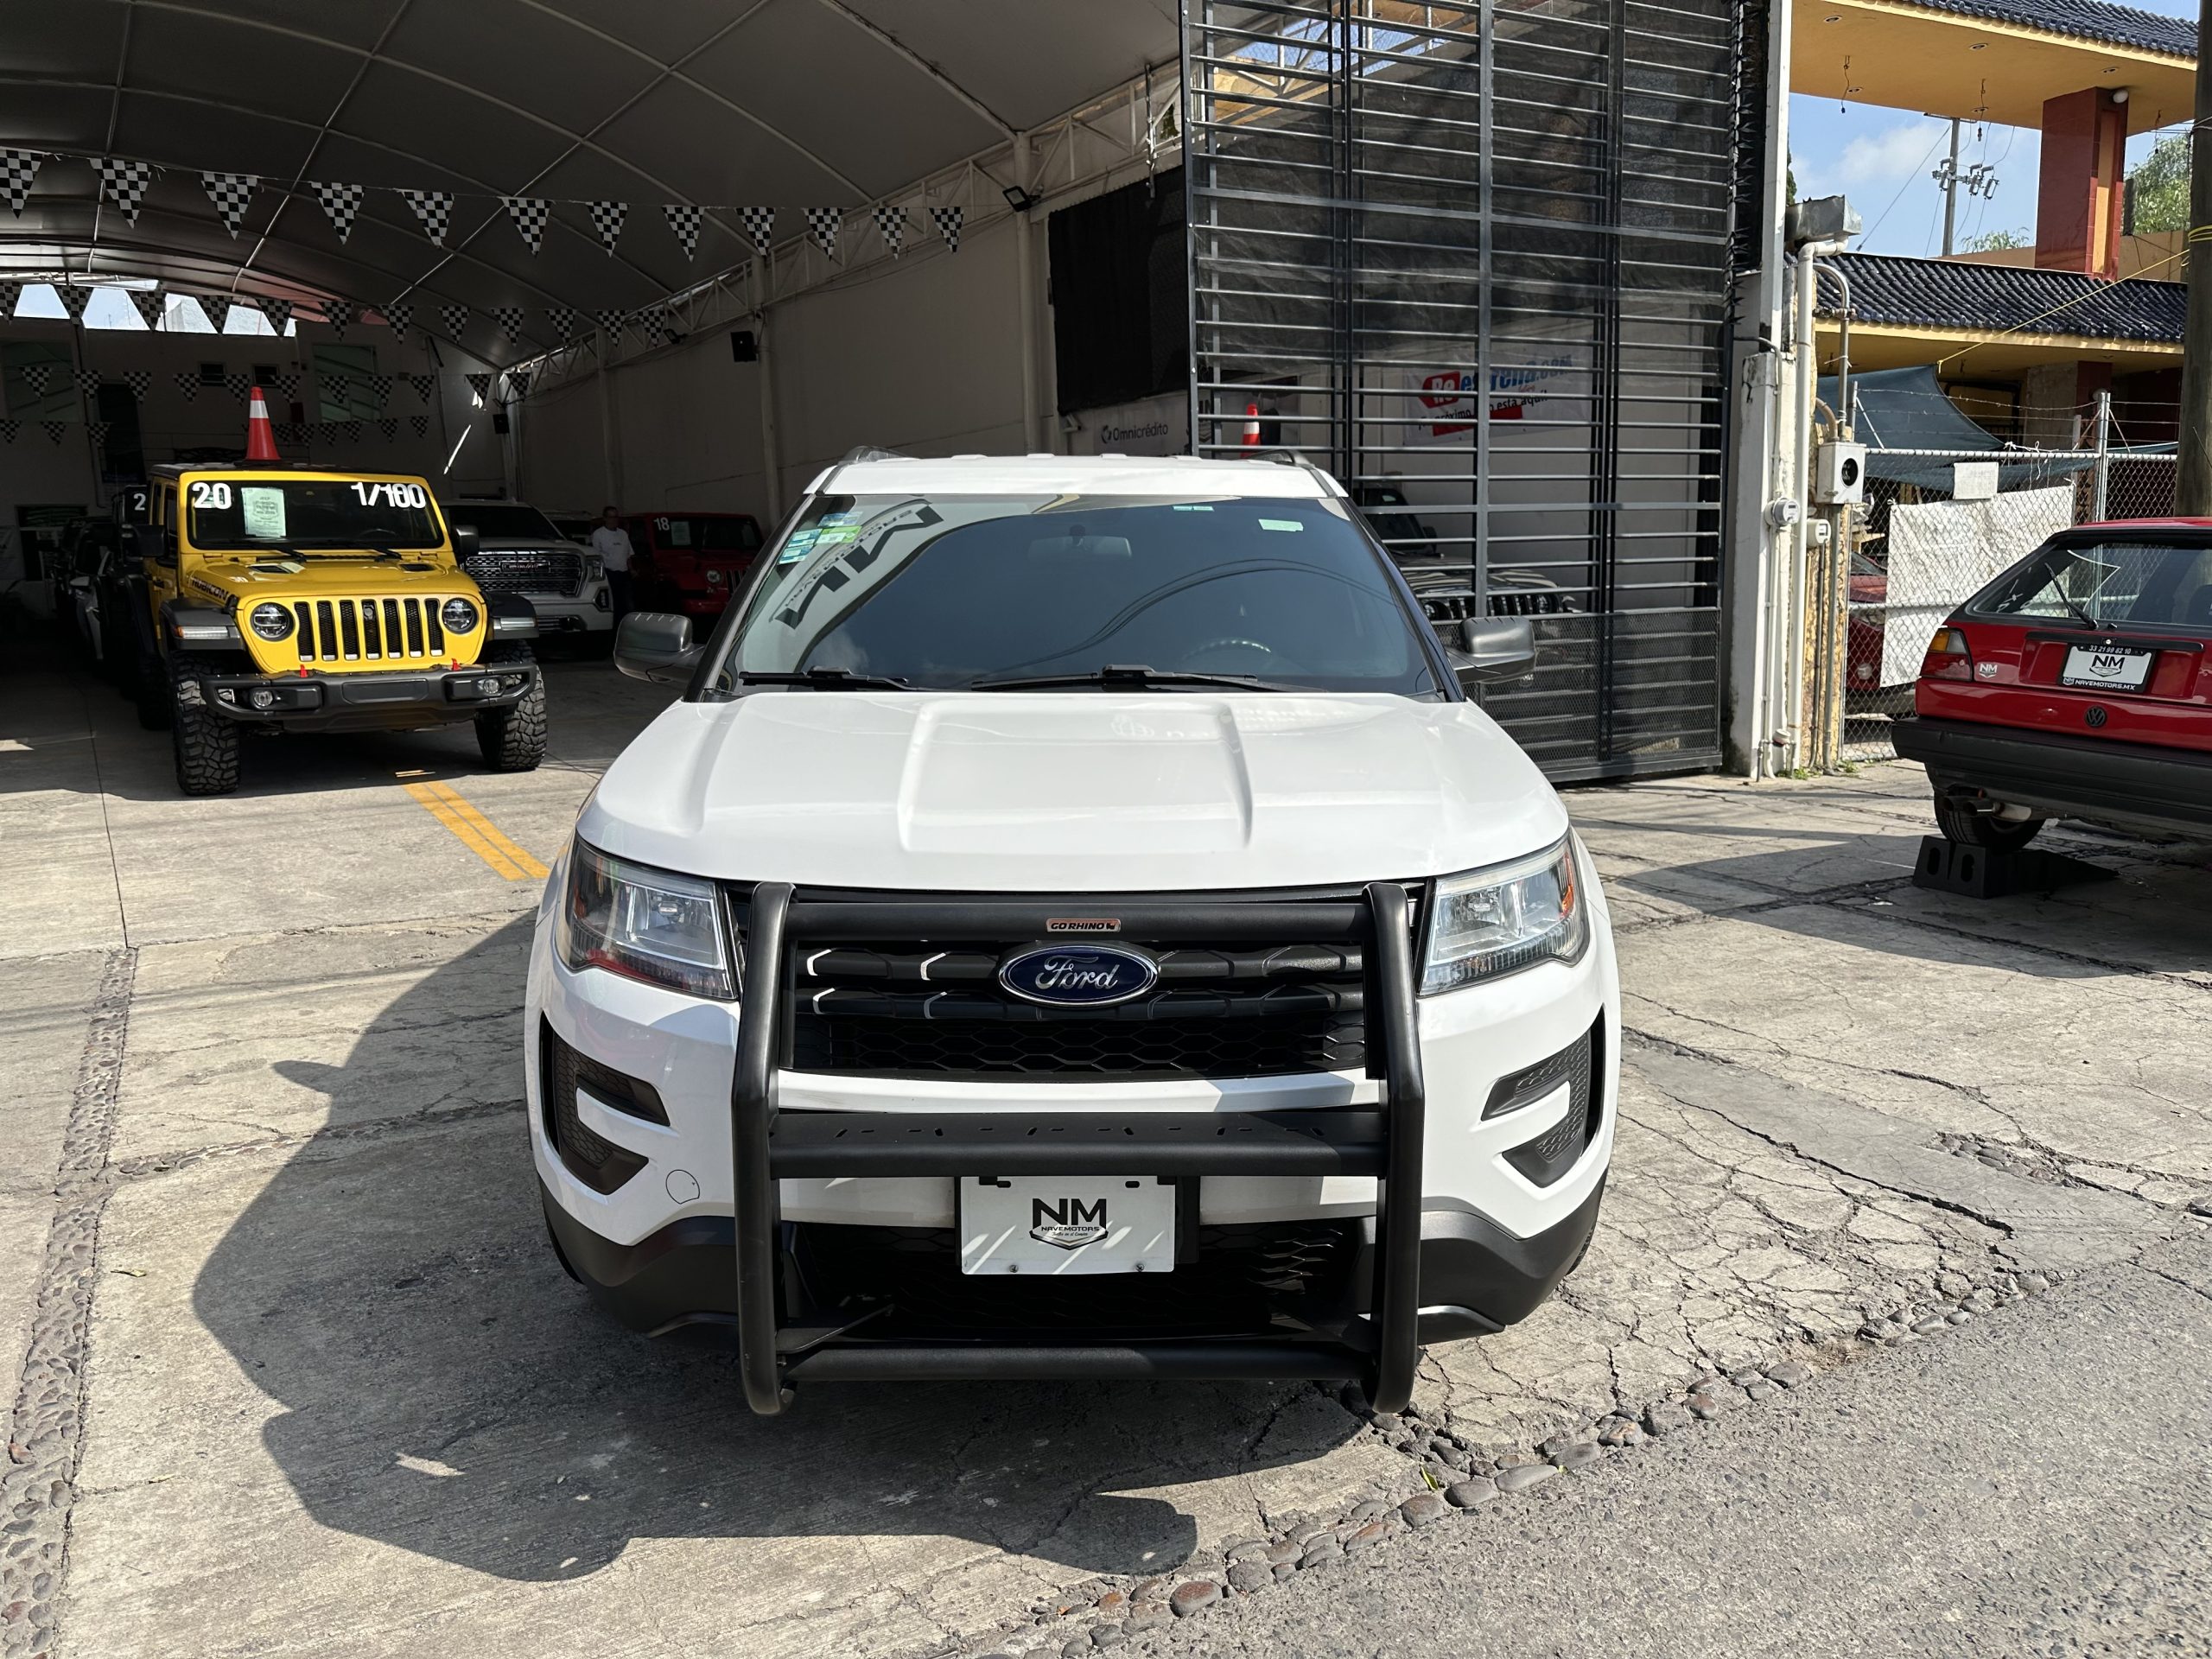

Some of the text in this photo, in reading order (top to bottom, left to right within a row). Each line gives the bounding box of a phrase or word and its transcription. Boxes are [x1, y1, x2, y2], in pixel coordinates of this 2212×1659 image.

[1113, 422, 1168, 441] Omnicrédito
[192, 482, 232, 510] 20
[653, 517, 670, 531] 18
[1979, 663, 1998, 673] NM
[2092, 654, 2126, 670] NM
[2075, 679, 2136, 690] NAVEMOTORS.MX
[1035, 955, 1120, 989] Ford
[1033, 1198, 1107, 1229] NM
